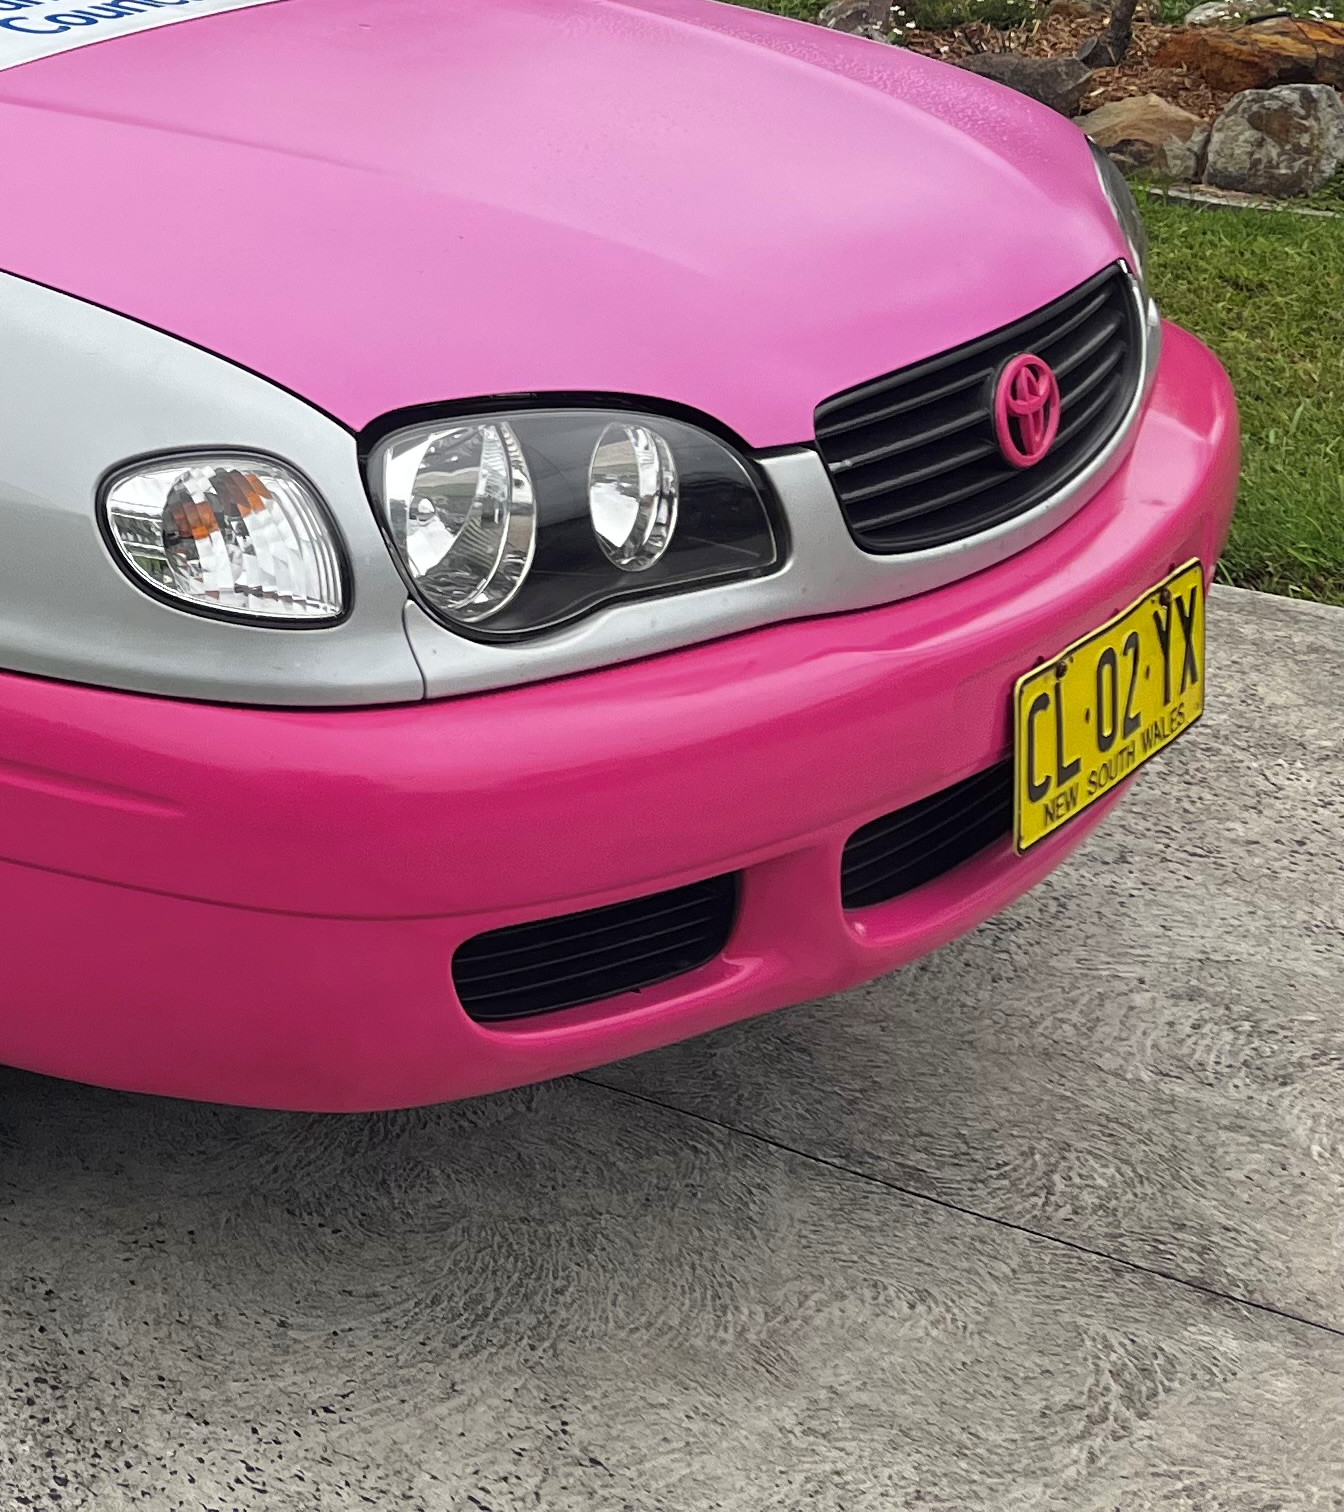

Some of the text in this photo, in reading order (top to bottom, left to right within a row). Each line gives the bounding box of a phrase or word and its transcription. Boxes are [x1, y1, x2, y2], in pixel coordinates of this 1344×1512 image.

[1043, 701, 1187, 828] NEW SOUTH WALES
